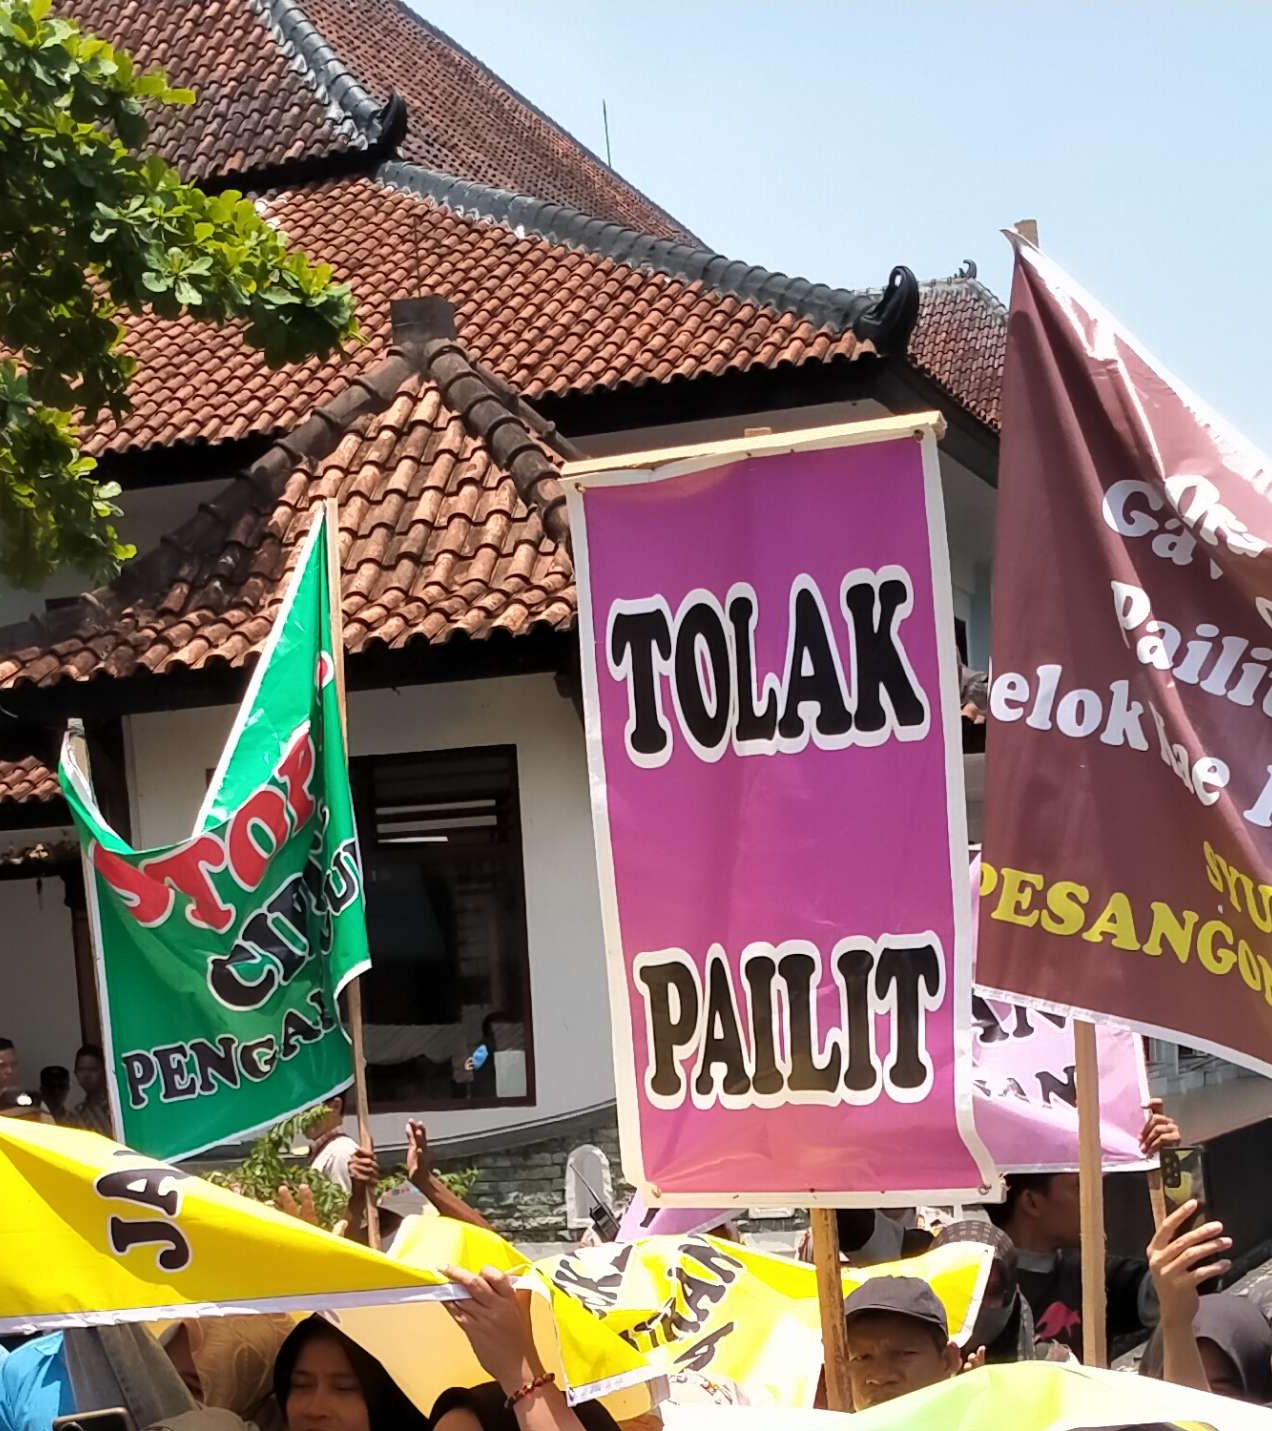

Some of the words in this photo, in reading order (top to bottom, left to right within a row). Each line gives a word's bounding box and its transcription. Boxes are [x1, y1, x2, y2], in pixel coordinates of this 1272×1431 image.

[610, 578, 926, 755] TOLAK
[986, 655, 1149, 752] elok
[639, 943, 941, 1097] PAILIT
